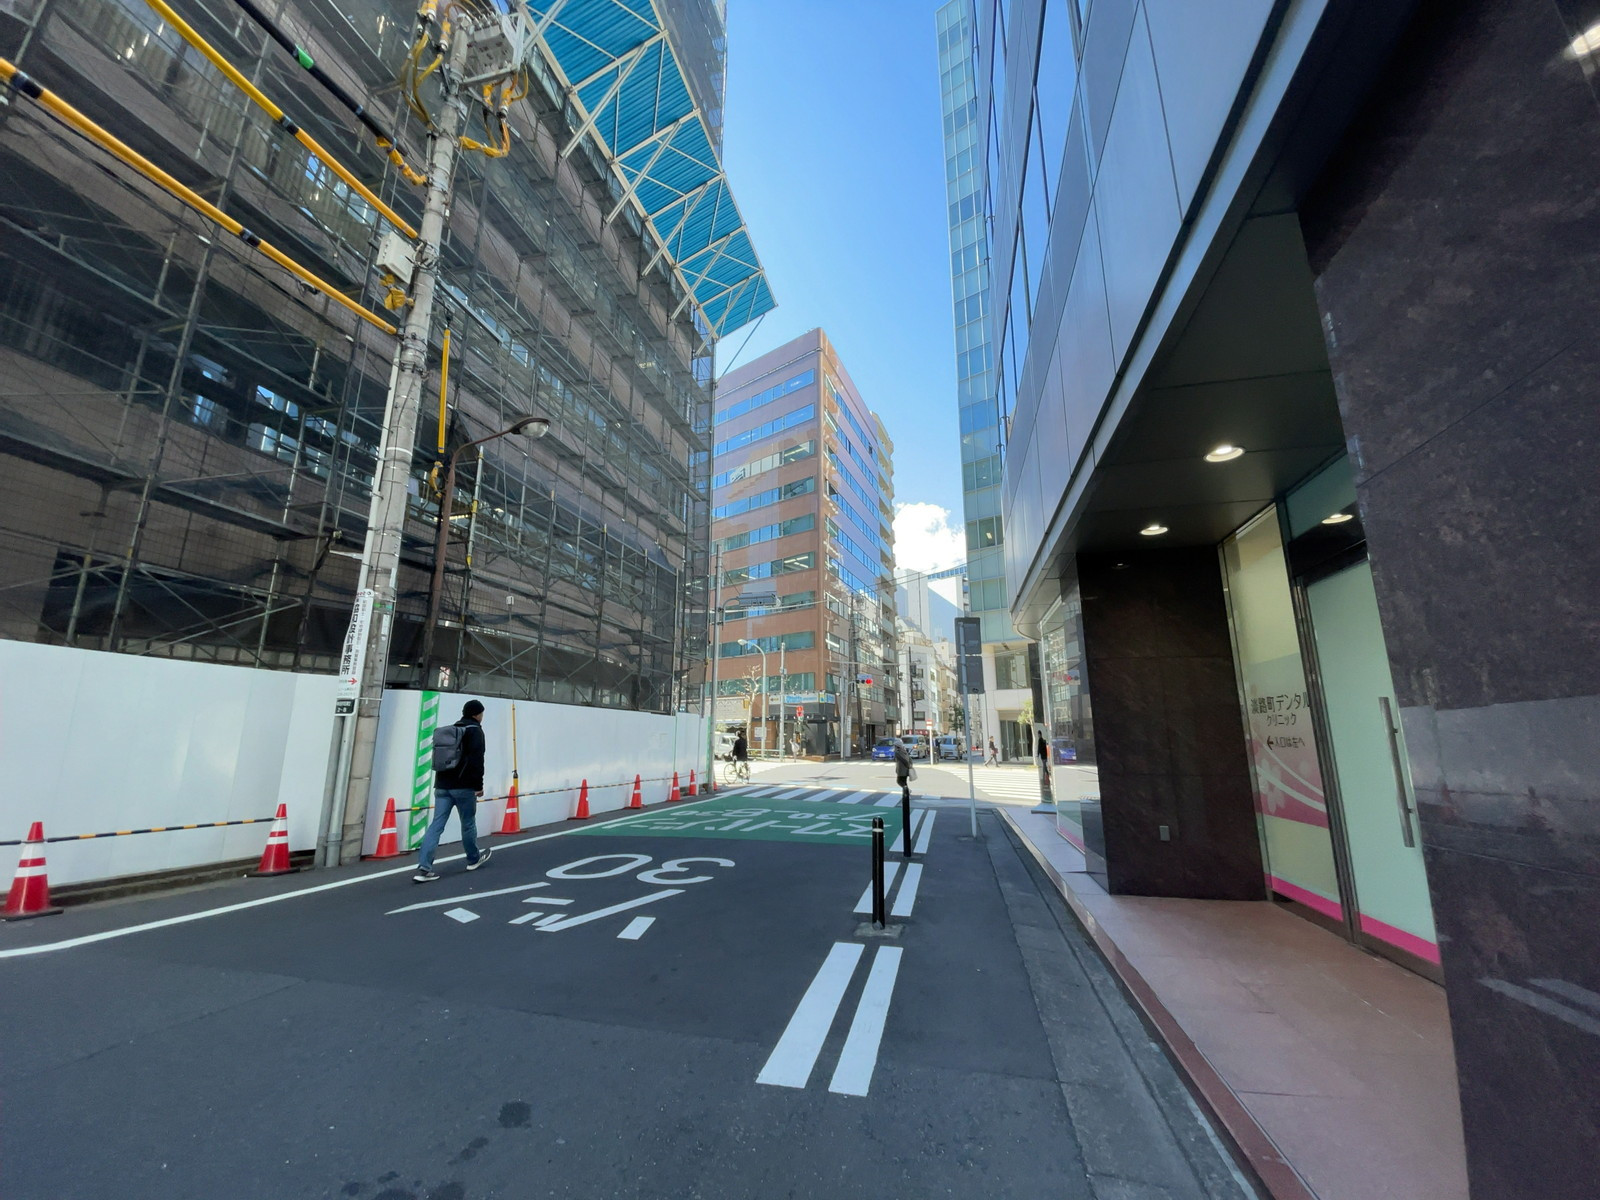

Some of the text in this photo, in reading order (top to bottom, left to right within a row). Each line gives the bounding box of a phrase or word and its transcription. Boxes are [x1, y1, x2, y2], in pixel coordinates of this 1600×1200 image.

[1250, 692, 1310, 714] 淡路町デンタル
[1267, 712, 1297, 727] クリニック
[1275, 736, 1306, 749] 入口は左へ
[602, 817, 892, 838] スクールゾーン
[546, 853, 736, 885] 30
[385, 881, 687, 940] ゾーン
